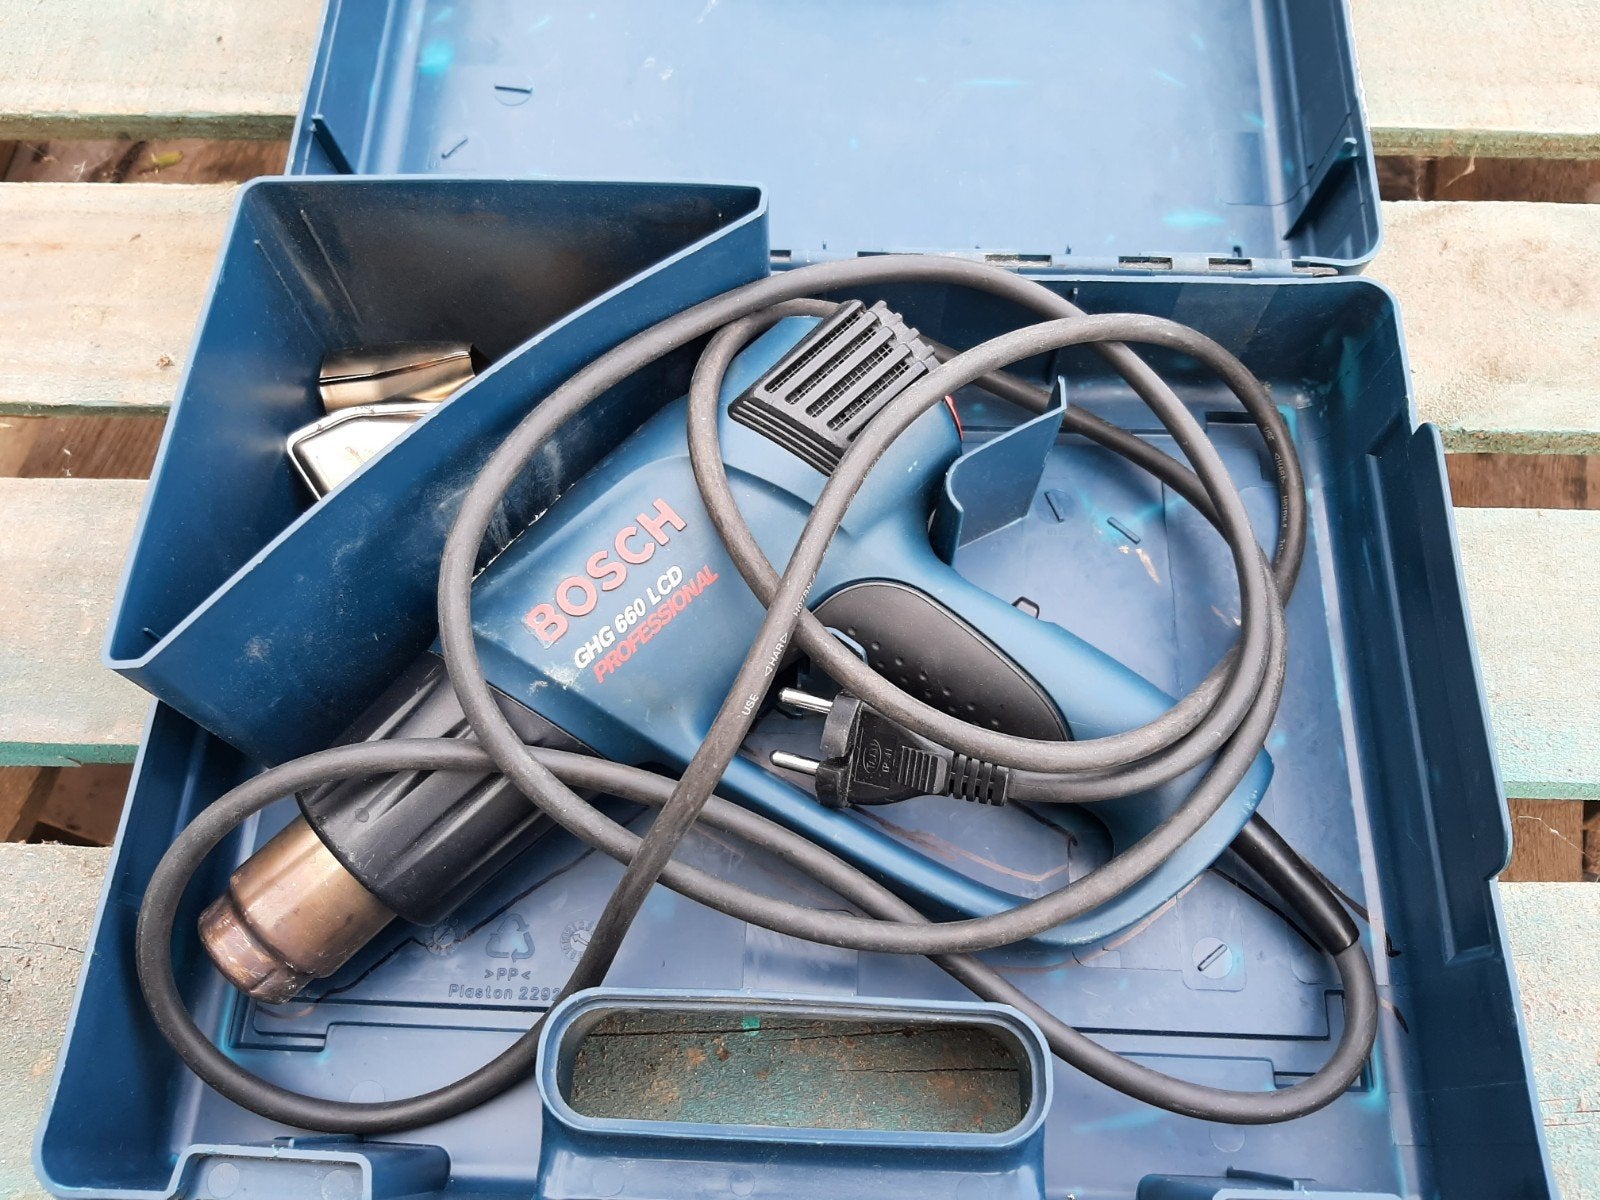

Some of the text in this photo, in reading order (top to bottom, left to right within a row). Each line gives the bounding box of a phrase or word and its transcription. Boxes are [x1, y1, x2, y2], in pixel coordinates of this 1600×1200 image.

[523, 498, 687, 648] BOSCH
[574, 565, 683, 669] GHG 660 LCD
[593, 565, 720, 683] PROFESSIONAL
[741, 693, 759, 716] USE
[448, 983, 513, 1000] Plaston
